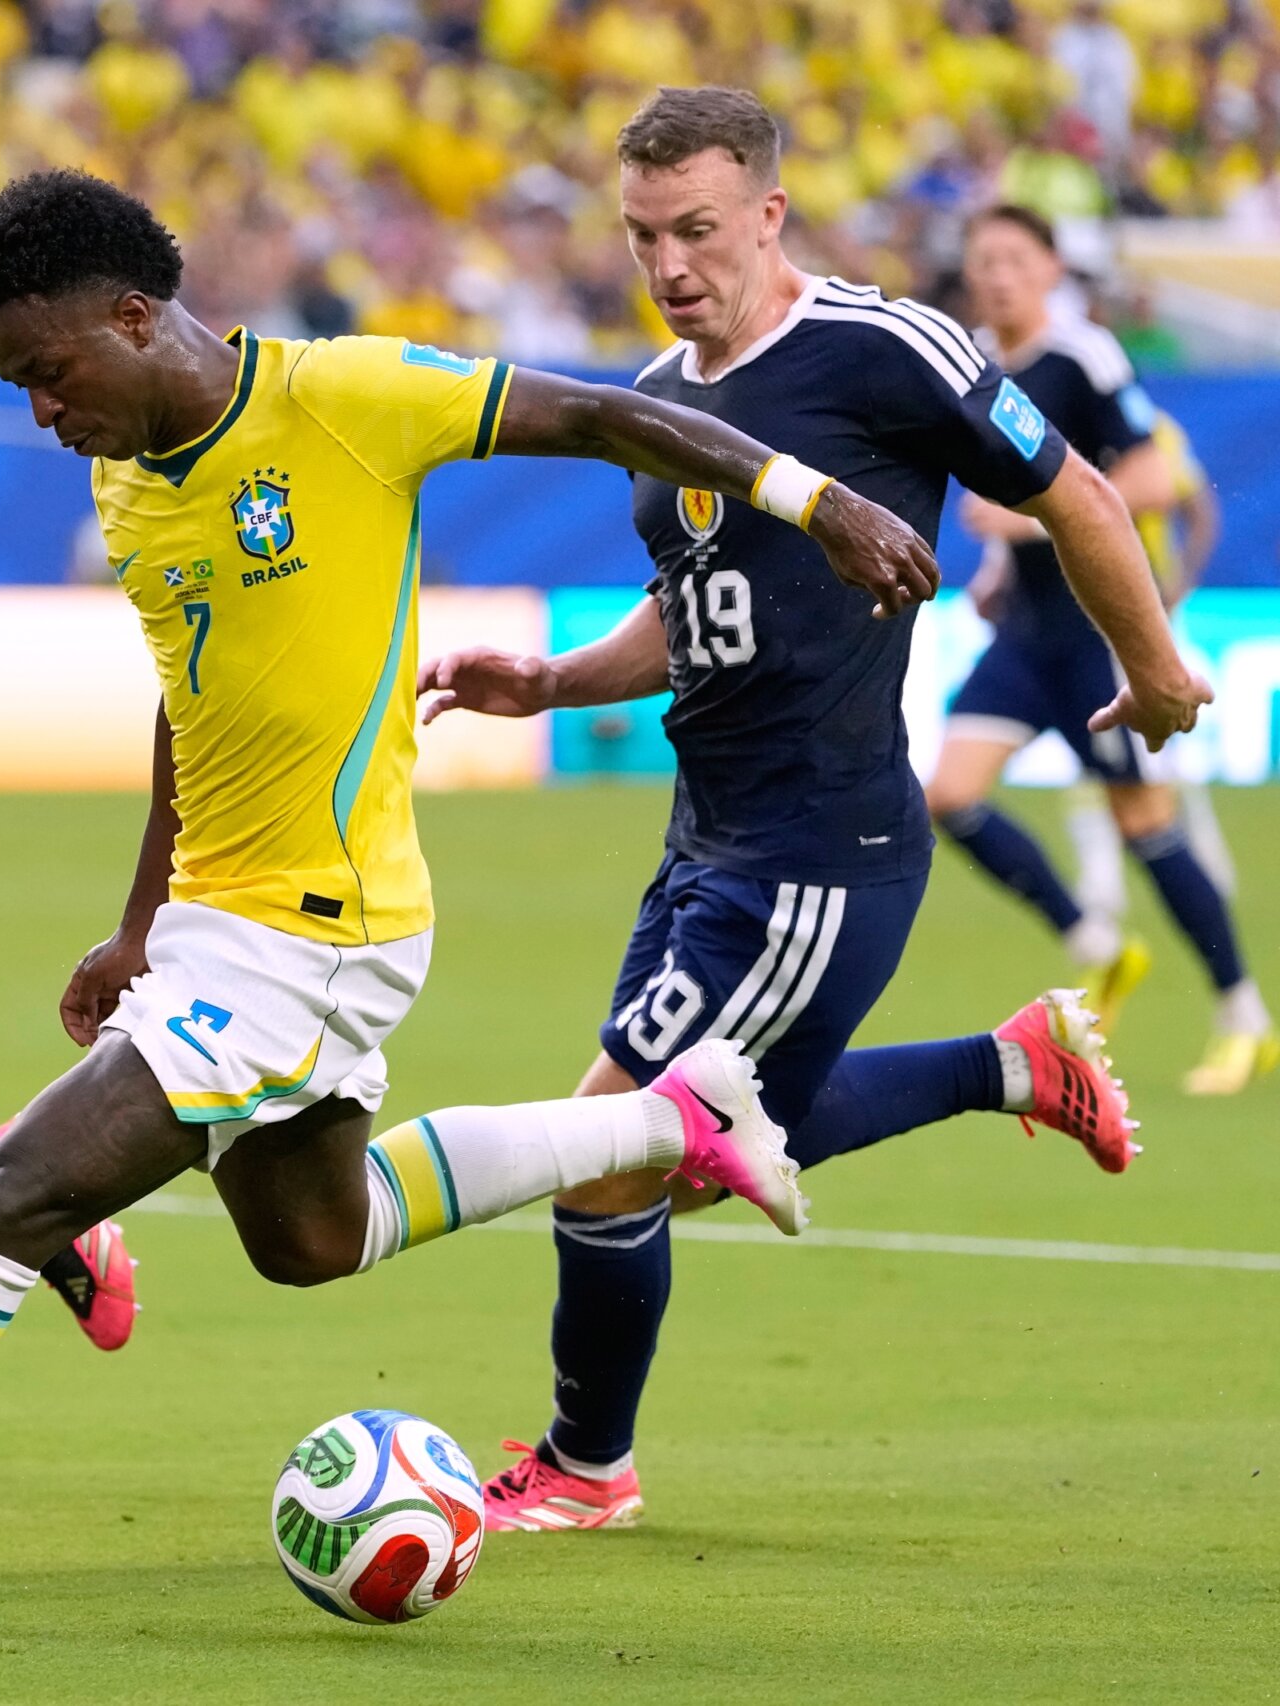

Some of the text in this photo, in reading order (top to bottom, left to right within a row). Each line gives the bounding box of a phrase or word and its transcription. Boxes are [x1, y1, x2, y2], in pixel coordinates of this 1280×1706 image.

[250, 511, 273, 526] CBF
[241, 557, 308, 588] BRASIL
[183, 602, 211, 694] 7
[681, 570, 757, 668] 19
[615, 948, 705, 1061] 19
